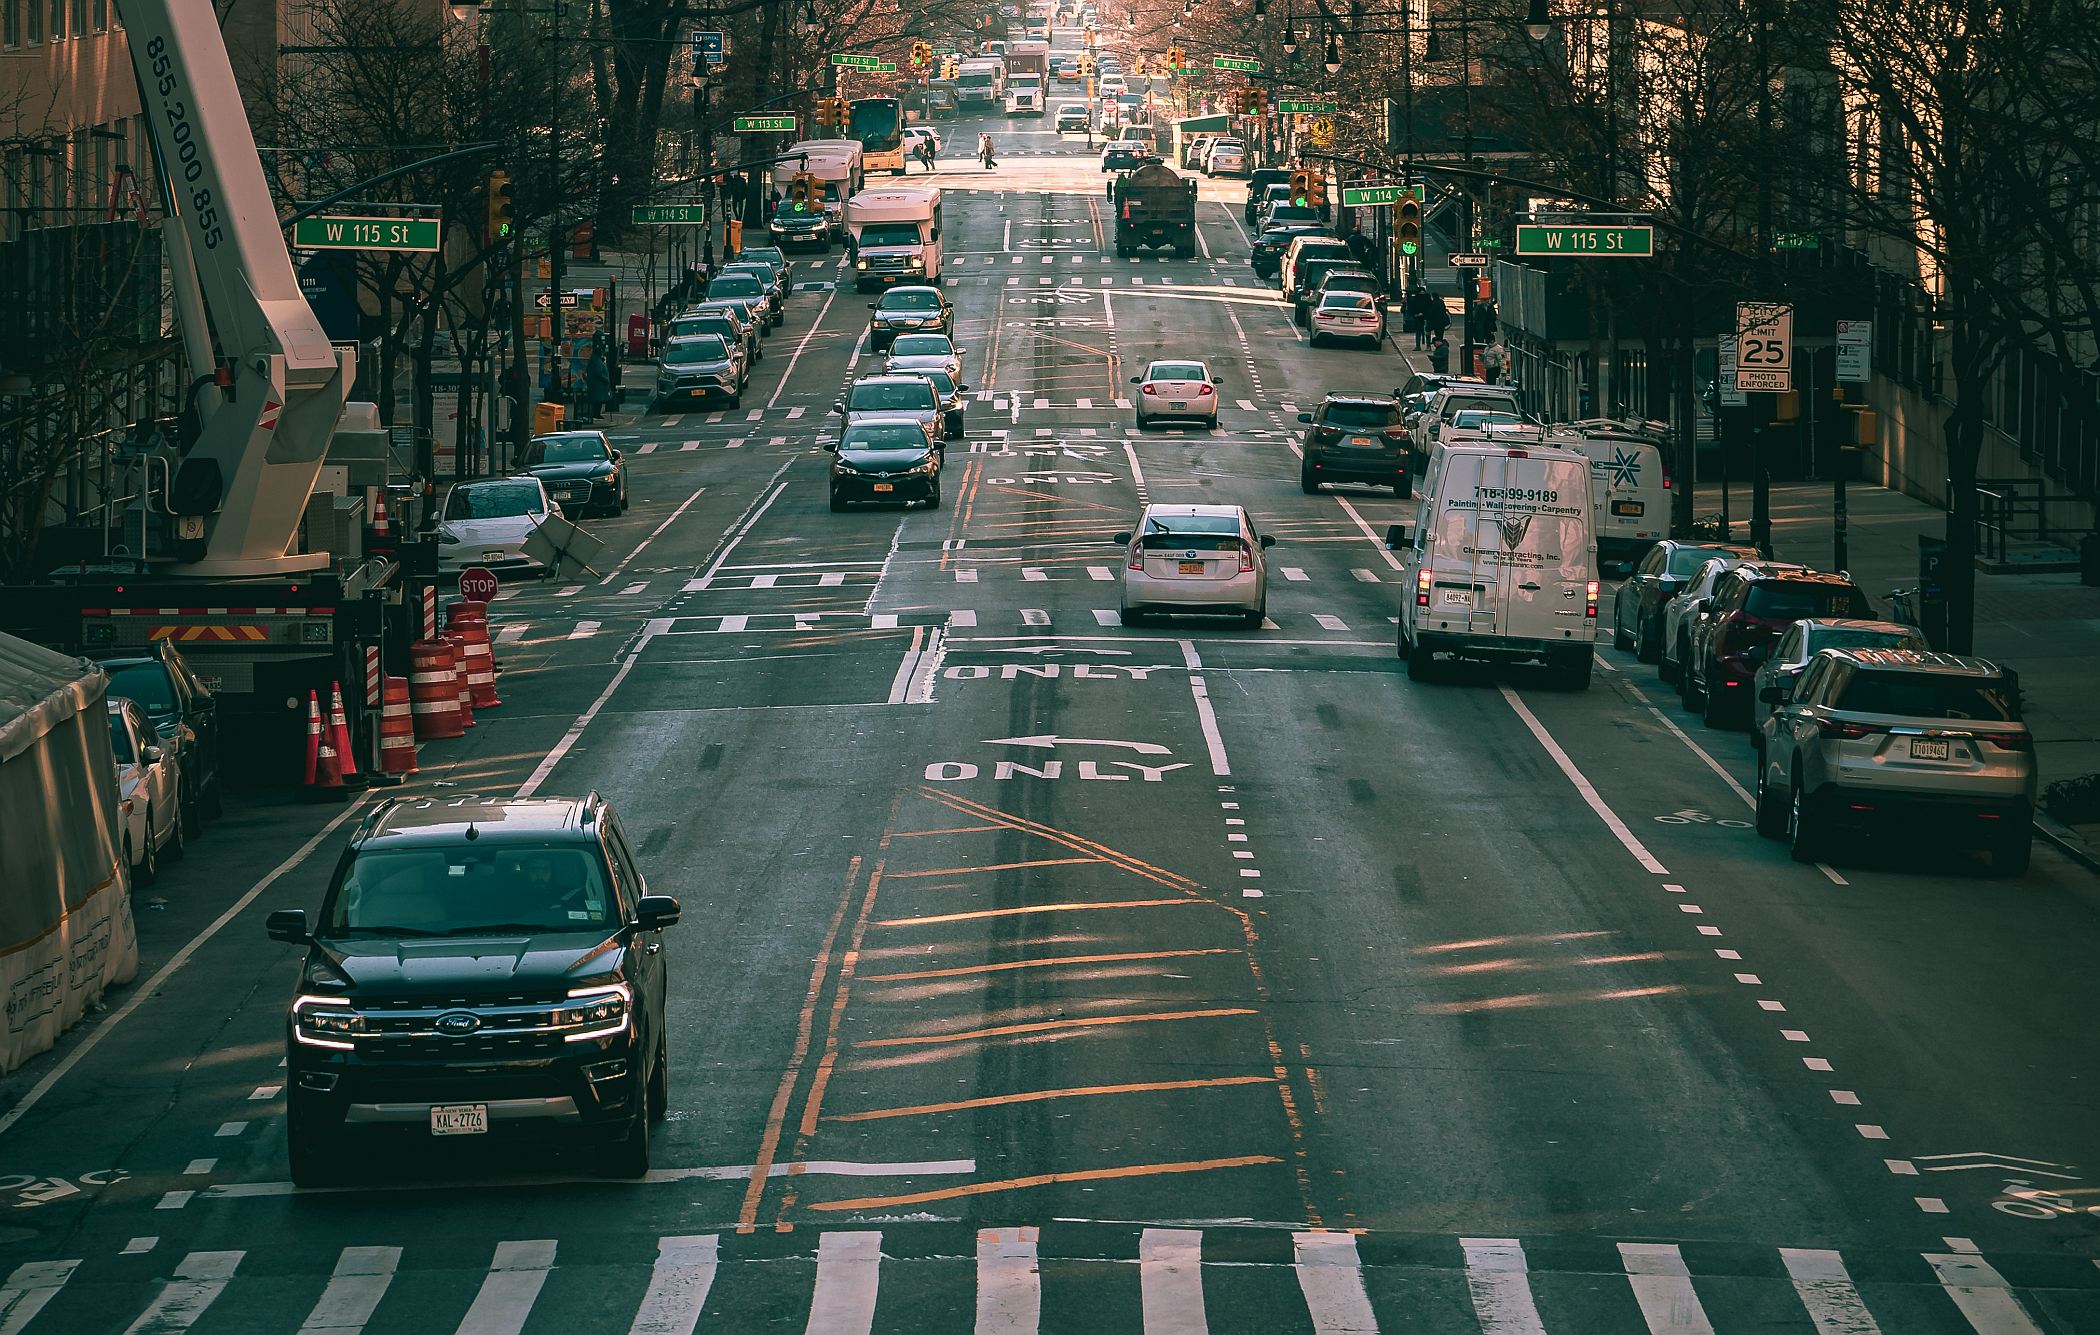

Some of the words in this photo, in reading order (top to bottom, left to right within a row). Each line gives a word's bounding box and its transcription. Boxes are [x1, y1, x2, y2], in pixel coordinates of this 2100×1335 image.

[1291, 102, 1299, 111] W
[1301, 102, 1313, 111] 113
[746, 120, 755, 129] W
[758, 120, 771, 129] 113
[773, 120, 783, 129] St
[147, 35, 223, 250] 855.2000.855
[1360, 192, 1371, 202] W
[1375, 189, 1392, 201] 114
[648, 209, 657, 221] W
[661, 209, 675, 221] 114
[679, 207, 689, 220] St
[326, 223, 344, 242] W
[353, 224, 381, 243] 115
[390, 225, 409, 244] St
[1546, 232, 1563, 249] W
[1571, 232, 1597, 249] 115
[1606, 232, 1624, 250] St
[1753, 308, 1775, 316] CITY
[1751, 328, 1777, 336] LIMIT
[1743, 339, 1785, 364] 25
[1748, 373, 1777, 381] PHOTO
[1740, 380, 1785, 389] ENFORCED
[986, 476, 1124, 485] ONLY
[1448, 500, 1481, 509] Painting
[1486, 500, 1537, 513] Wallcovering
[1541, 504, 1582, 516] Carpentry
[1546, 553, 1561, 561] Inc.
[462, 579, 495, 593] STOP
[943, 664, 1172, 680] ONLY
[922, 760, 1195, 783] ONLY
[446, 1018, 471, 1028] Ford
